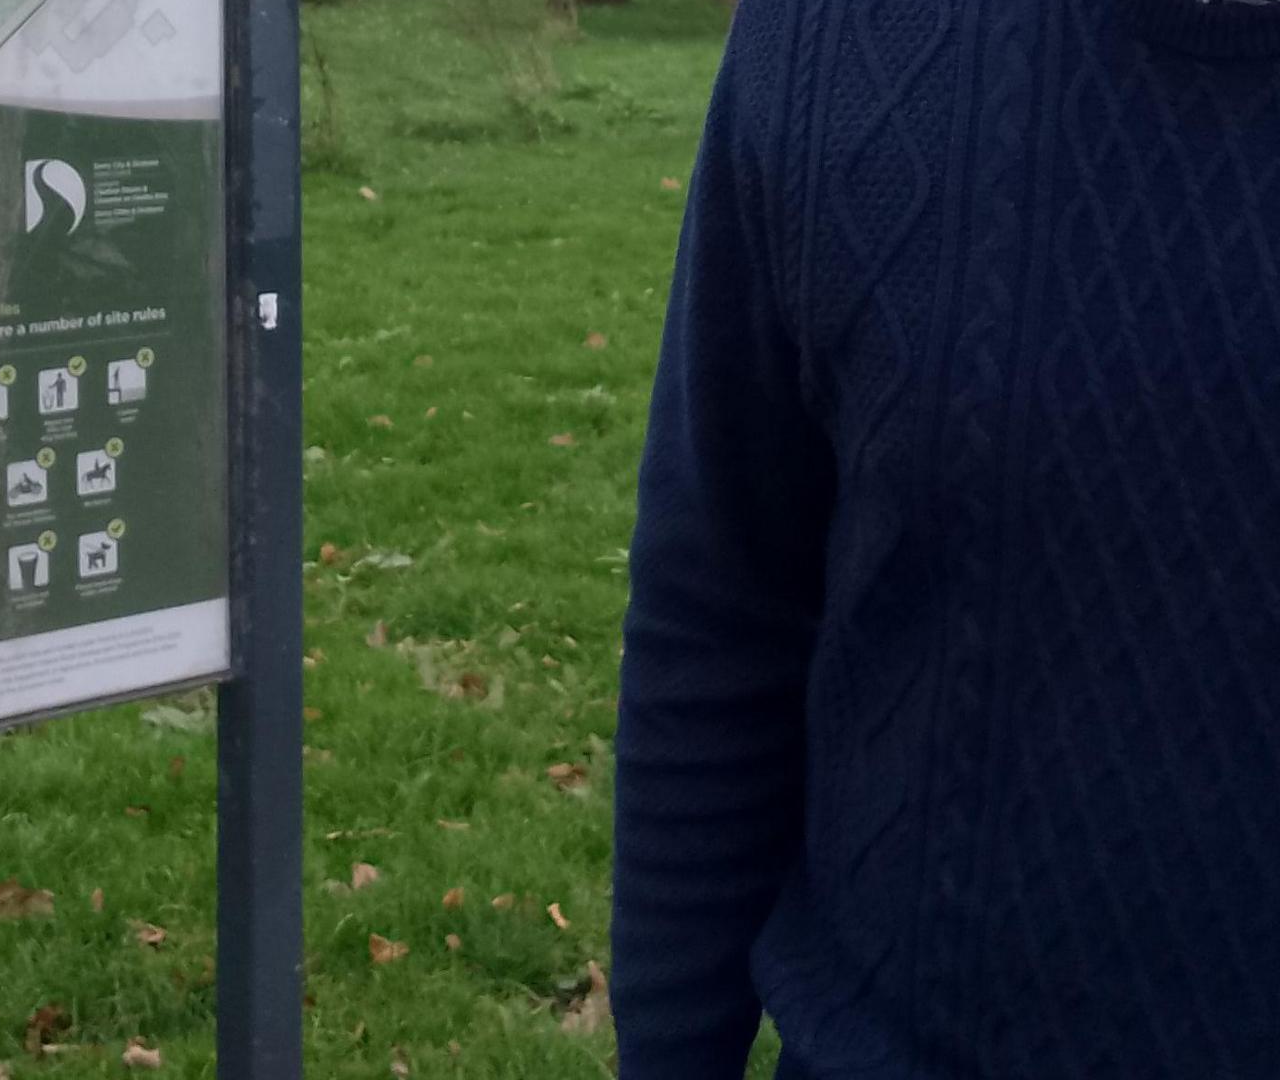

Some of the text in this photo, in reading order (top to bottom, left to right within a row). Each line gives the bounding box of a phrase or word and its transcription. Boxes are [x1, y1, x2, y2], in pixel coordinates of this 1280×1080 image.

[16, 323, 26, 336] a
[29, 315, 84, 335] number
[87, 311, 103, 328] of
[105, 310, 130, 326] site
[133, 306, 166, 322] rules
